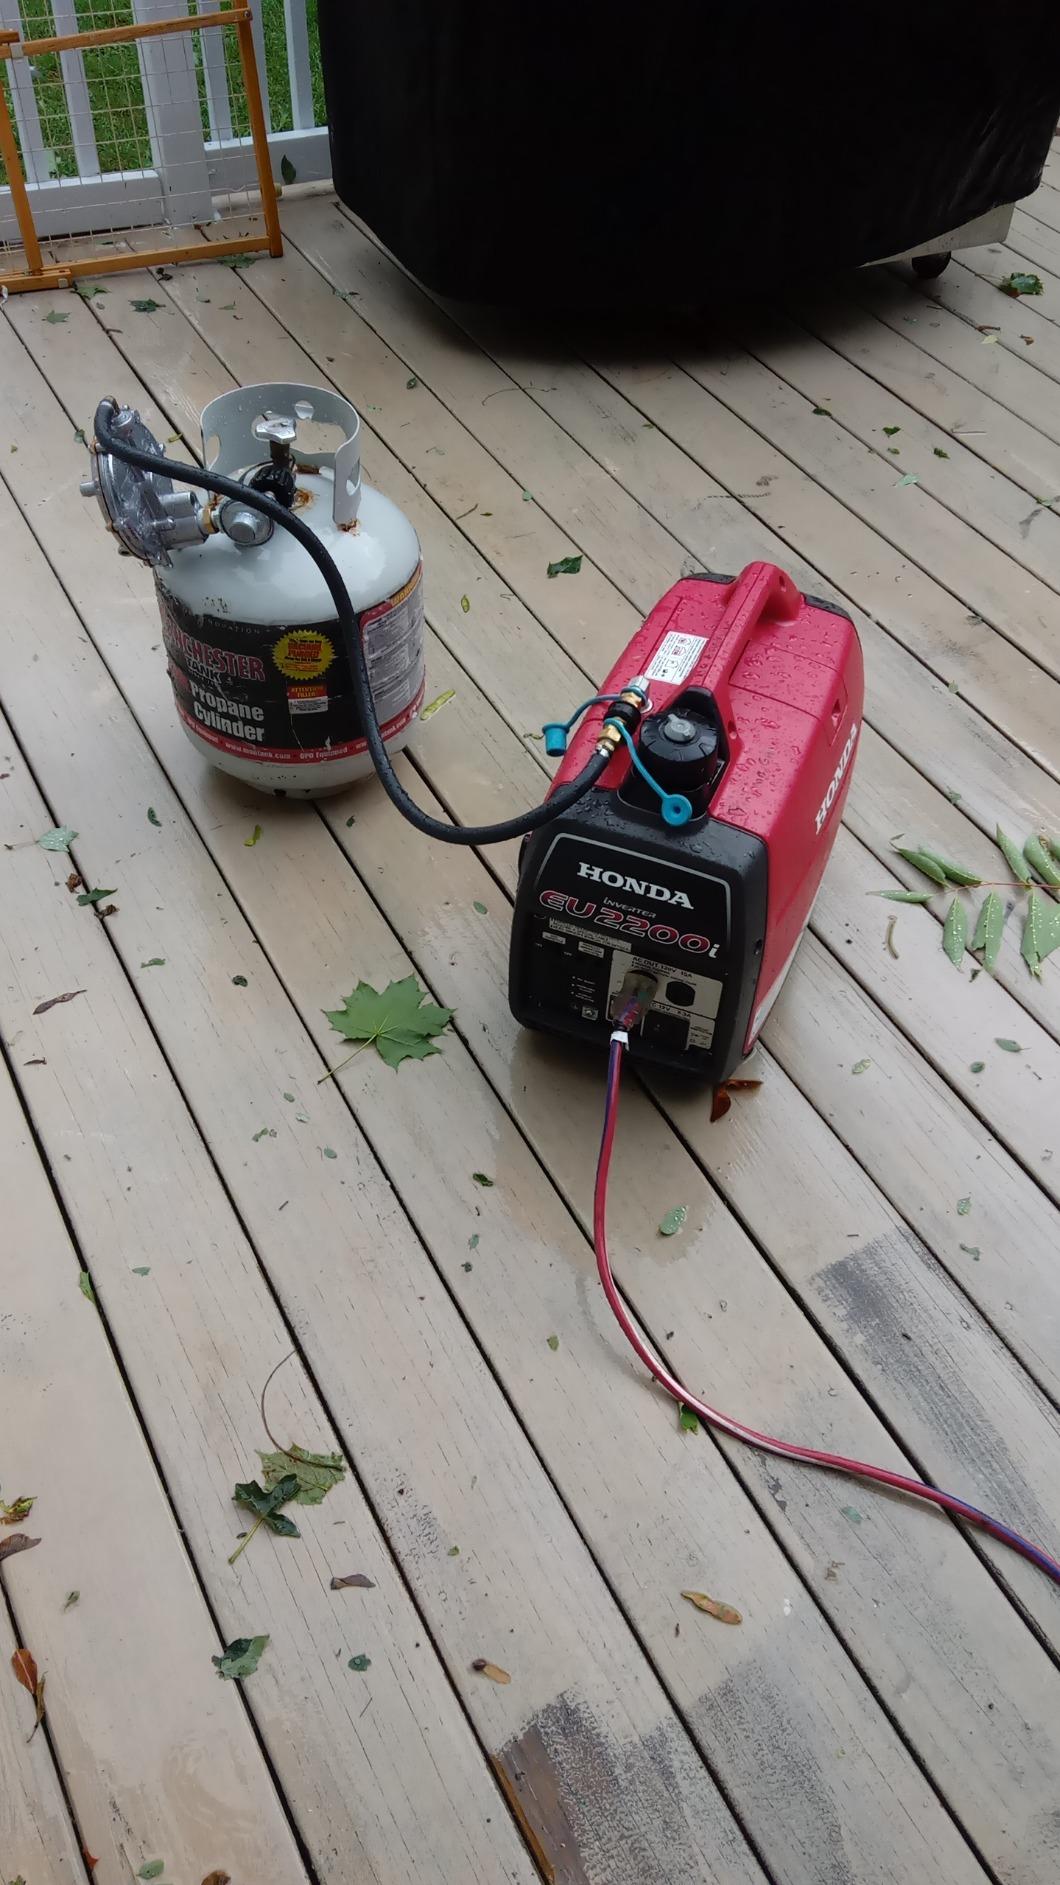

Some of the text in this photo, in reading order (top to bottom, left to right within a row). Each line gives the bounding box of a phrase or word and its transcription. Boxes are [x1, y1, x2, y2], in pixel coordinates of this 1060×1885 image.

[185, 657, 222, 684] TANK
[188, 679, 265, 721] Propane
[193, 700, 265, 742] Cylinder
[815, 723, 857, 836] HONDA
[577, 862, 694, 910] HONDA
[539, 890, 721, 959] EU2200i
